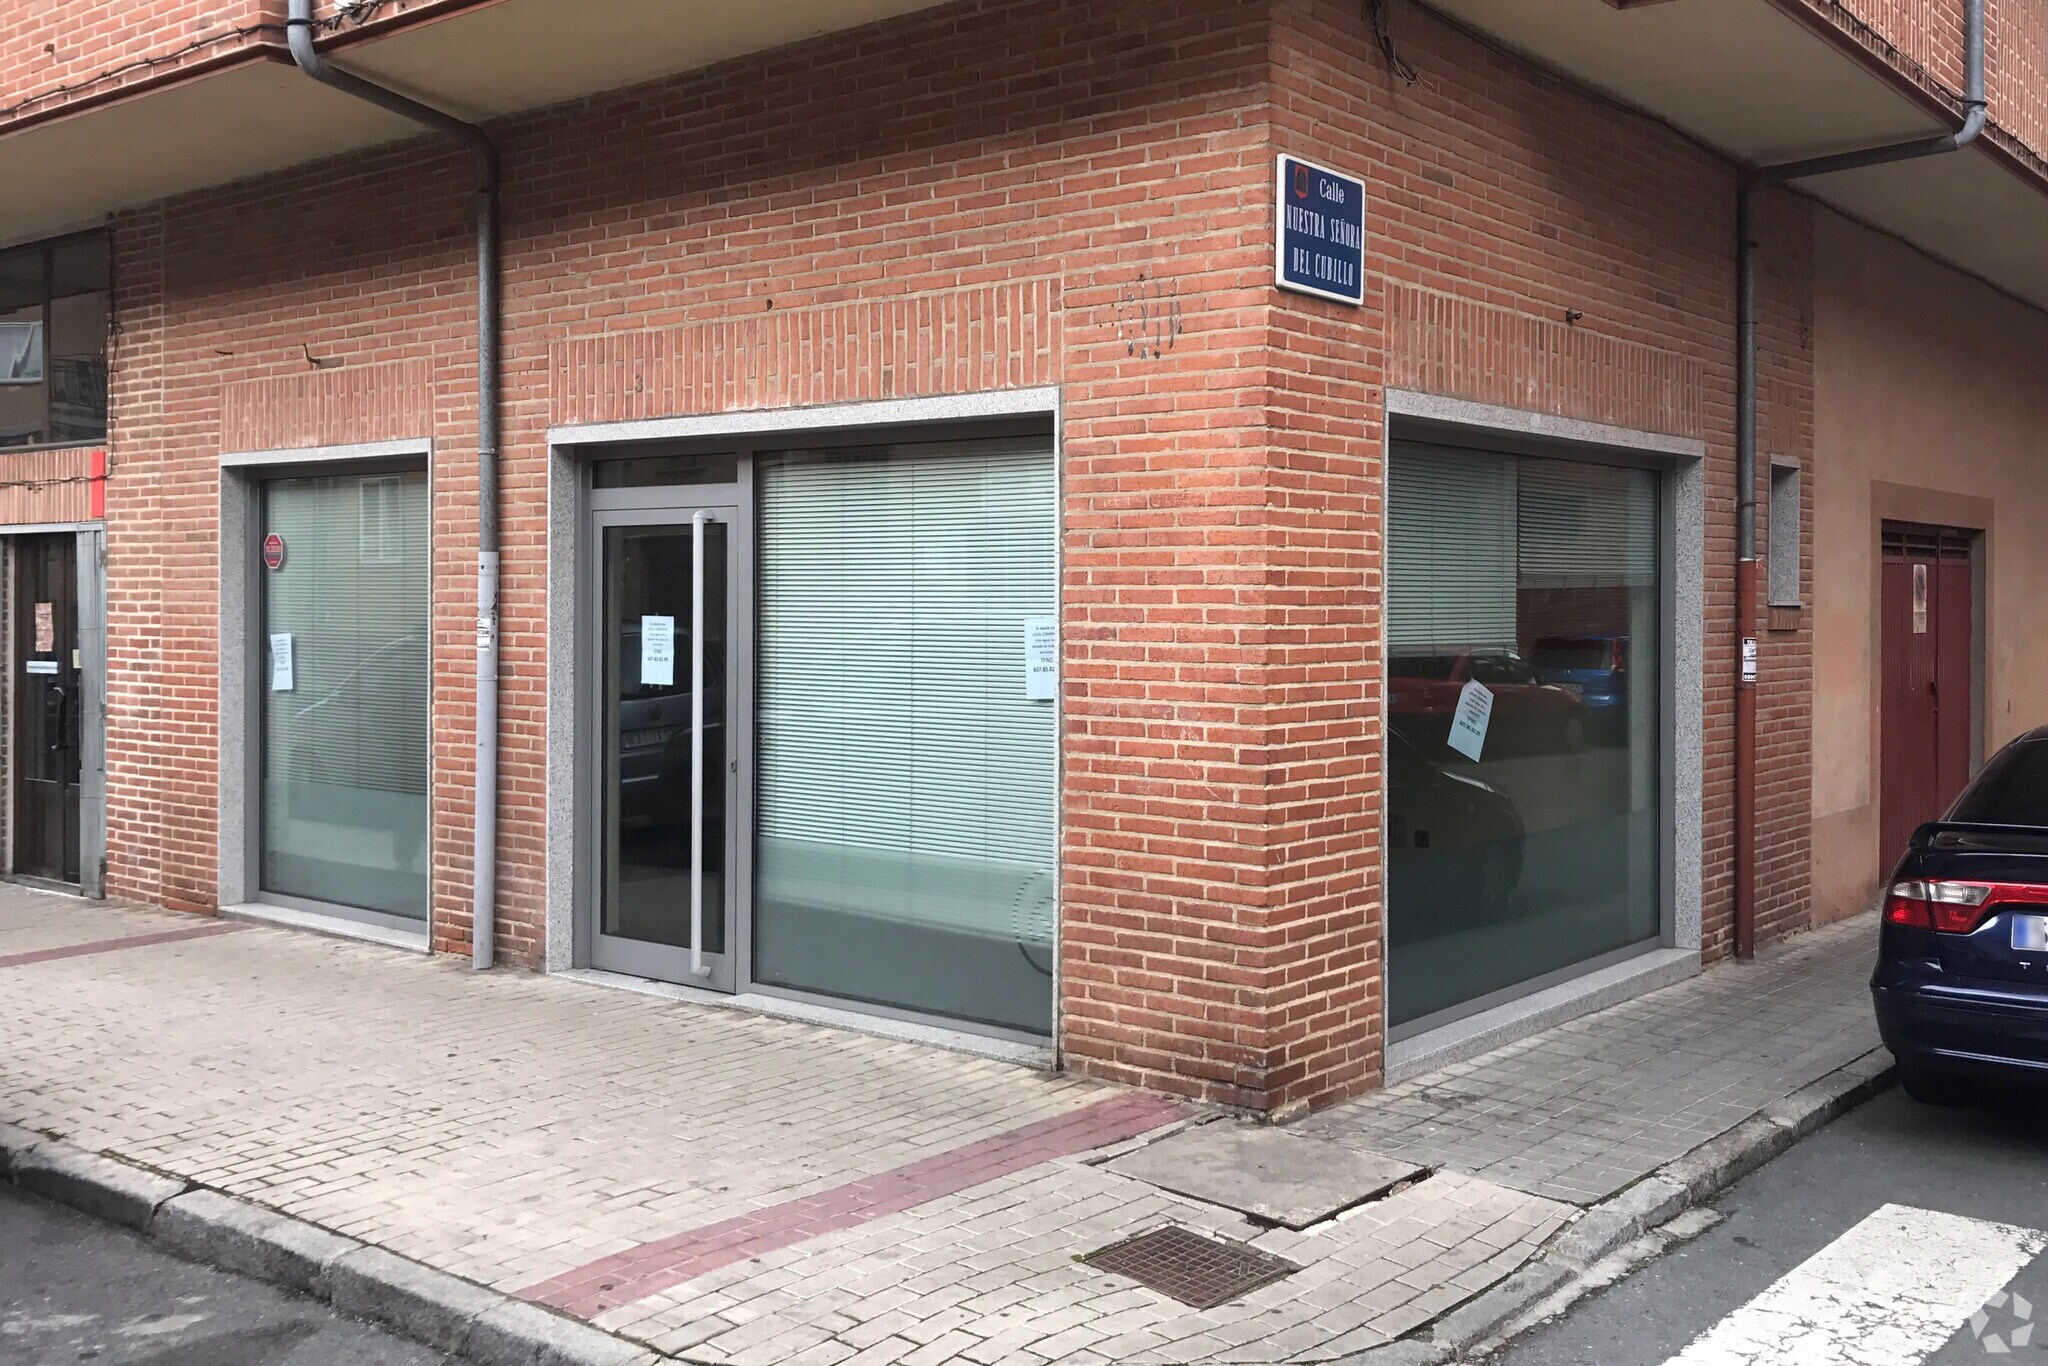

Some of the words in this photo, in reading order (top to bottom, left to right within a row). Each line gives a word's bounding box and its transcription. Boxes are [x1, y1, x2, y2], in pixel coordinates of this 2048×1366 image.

[1319, 178, 1345, 204] Calle
[1286, 204, 1325, 239] NUESTRA
[1330, 218, 1361, 250] SEÑORA
[1293, 246, 1310, 275] DEL
[1314, 253, 1354, 287] CUBILLO
